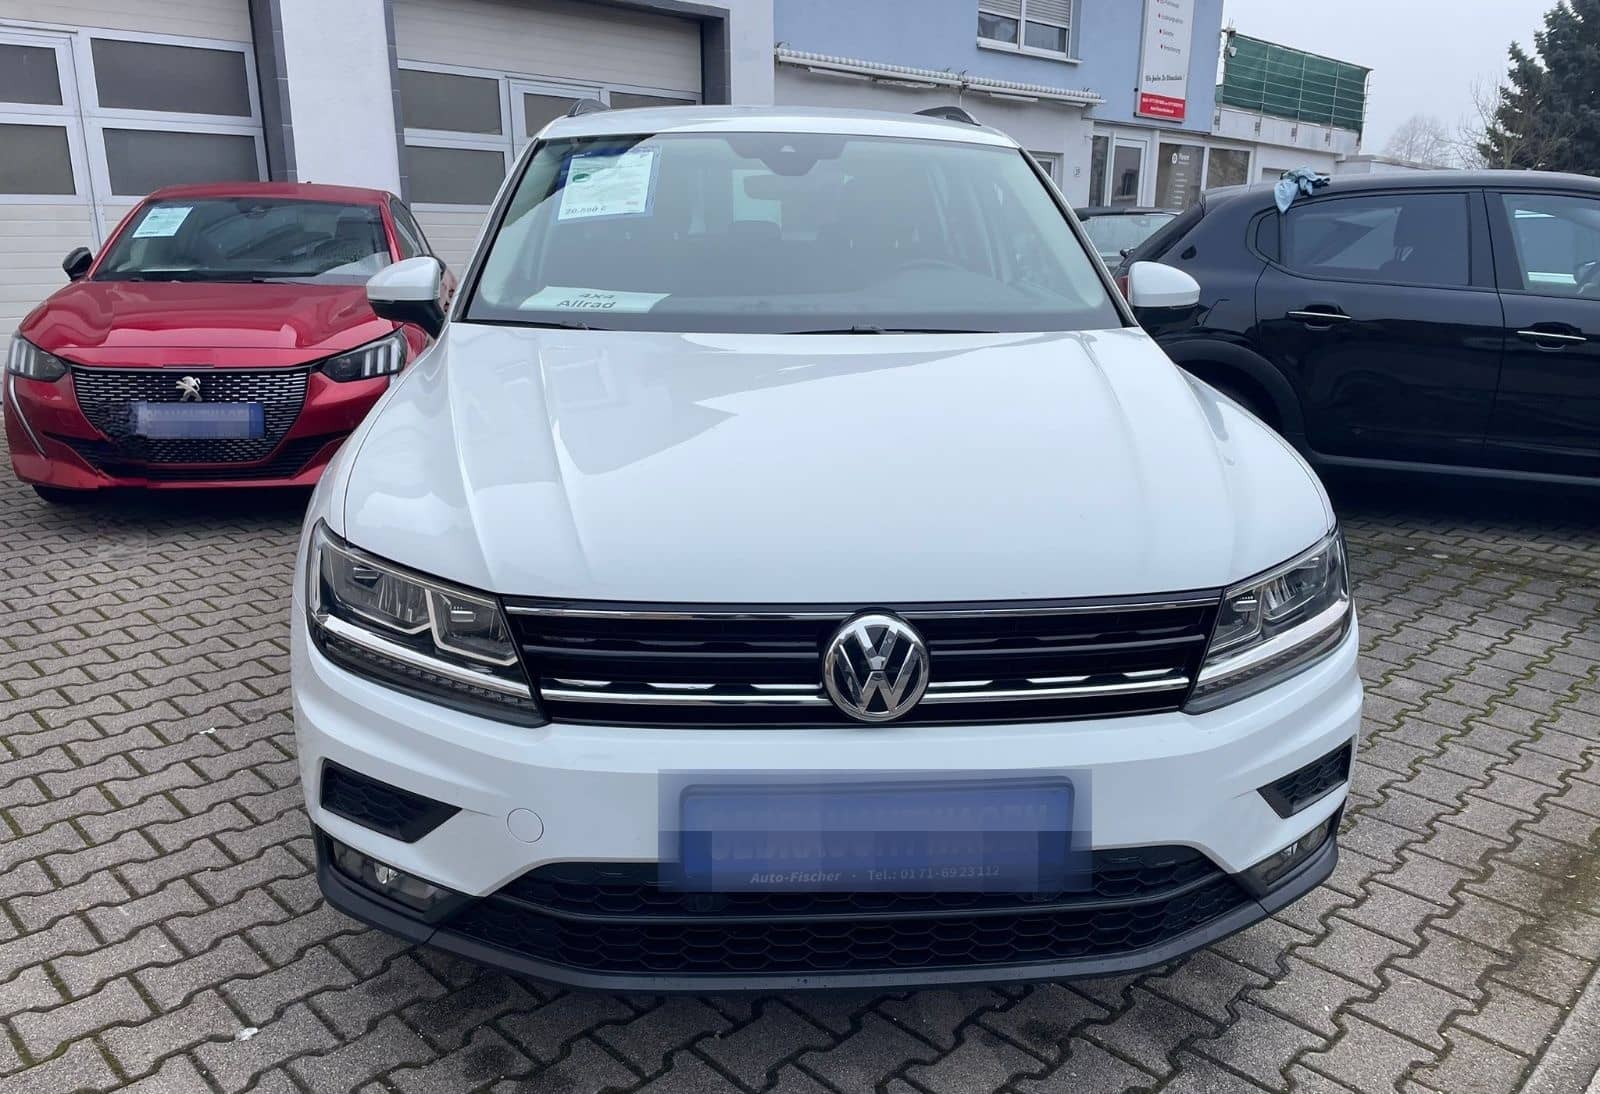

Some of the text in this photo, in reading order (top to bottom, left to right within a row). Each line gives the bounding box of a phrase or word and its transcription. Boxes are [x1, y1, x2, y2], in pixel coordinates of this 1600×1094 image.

[556, 300, 617, 308] Allrad
[832, 620, 922, 714] VW
[750, 871, 842, 884] Auto-Fischer
